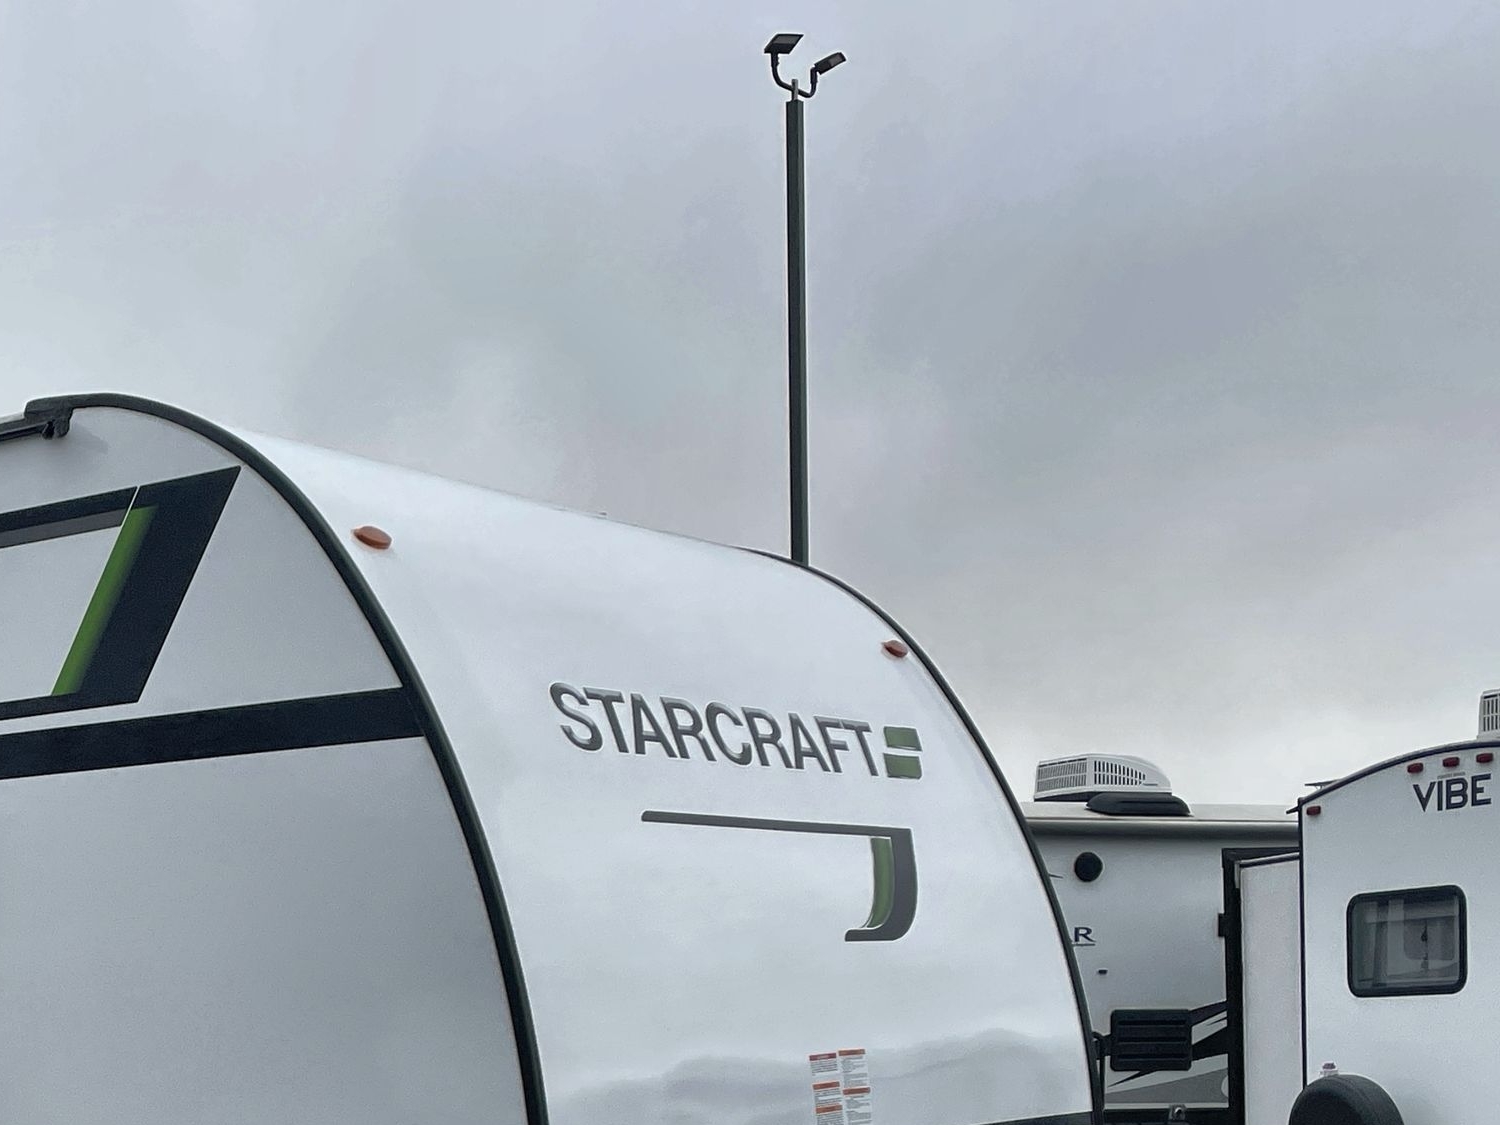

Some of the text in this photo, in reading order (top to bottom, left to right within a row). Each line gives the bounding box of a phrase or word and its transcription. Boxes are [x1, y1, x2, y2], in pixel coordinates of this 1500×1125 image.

[549, 681, 879, 776] STARCRAFT
[1412, 773, 1492, 812] VIBE
[1072, 926, 1097, 943] R
